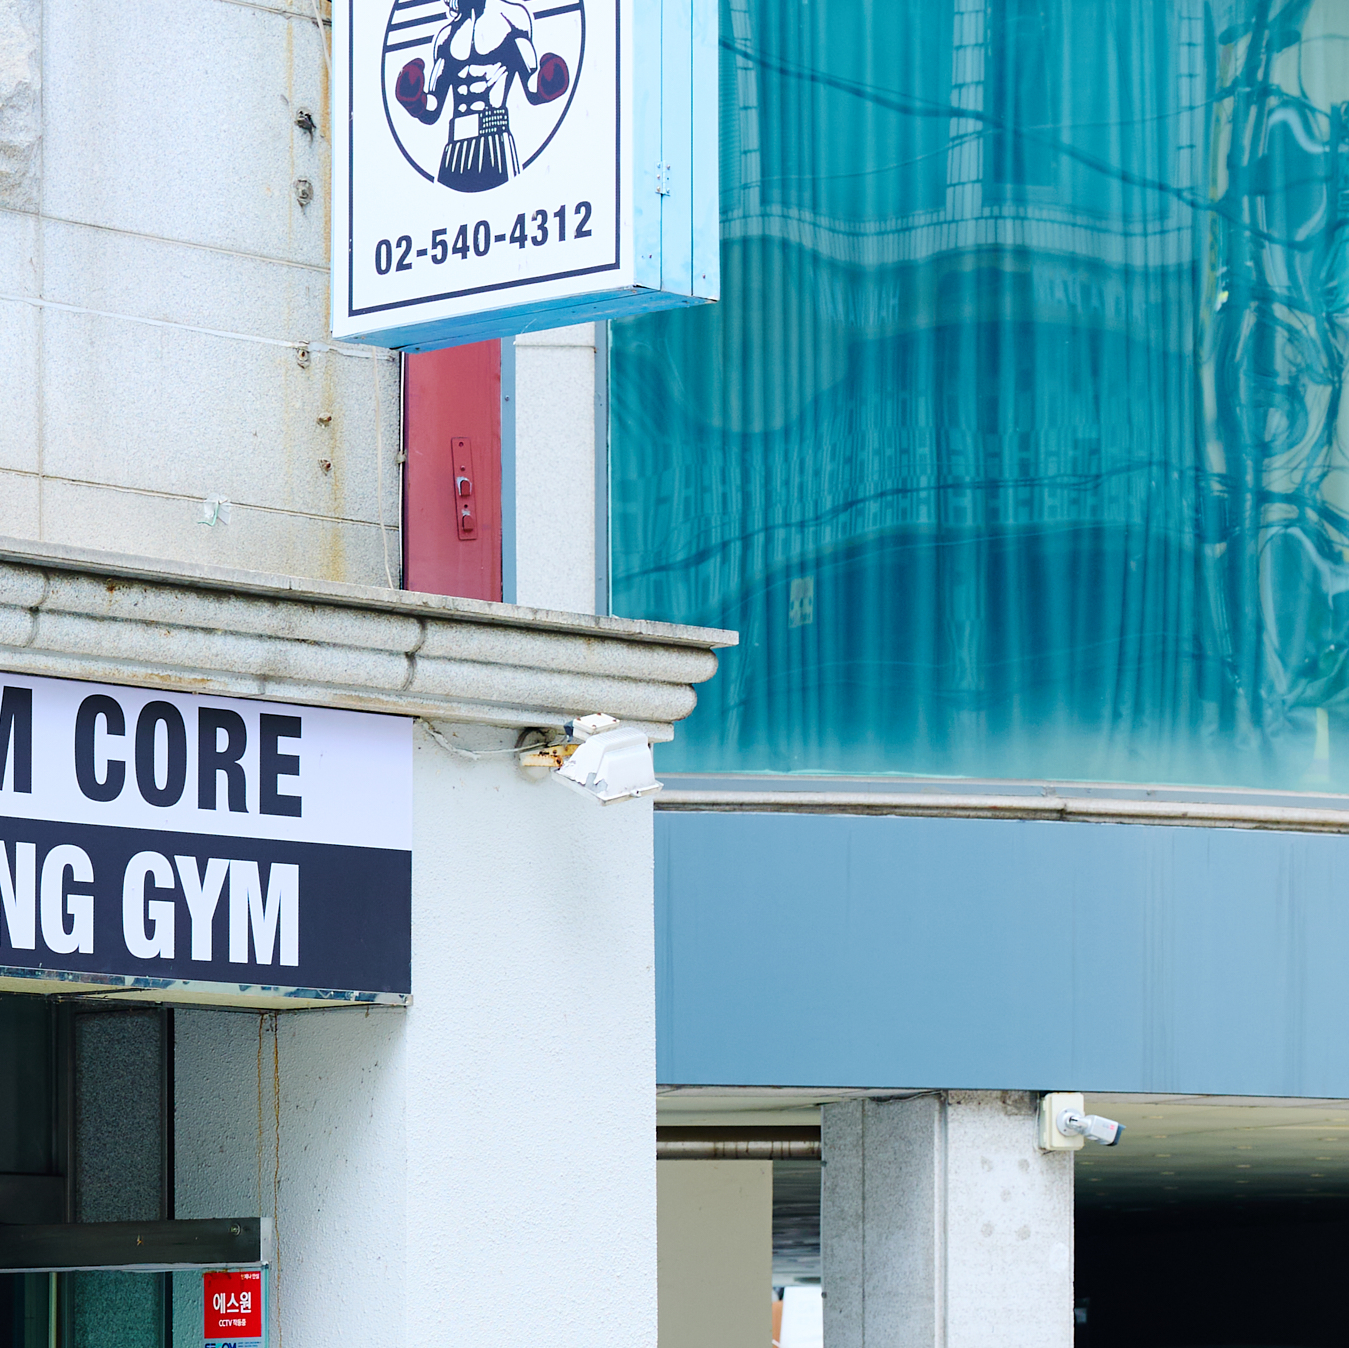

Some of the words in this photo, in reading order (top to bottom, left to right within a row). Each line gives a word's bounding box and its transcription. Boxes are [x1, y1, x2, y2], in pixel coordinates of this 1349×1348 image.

[375, 201, 593, 276] 02-540-4312
[74, 694, 303, 819] CORE
[122, 851, 300, 968] GYM
[213, 1291, 252, 1314] 에스원
[218, 1319, 232, 1327] CCTV
